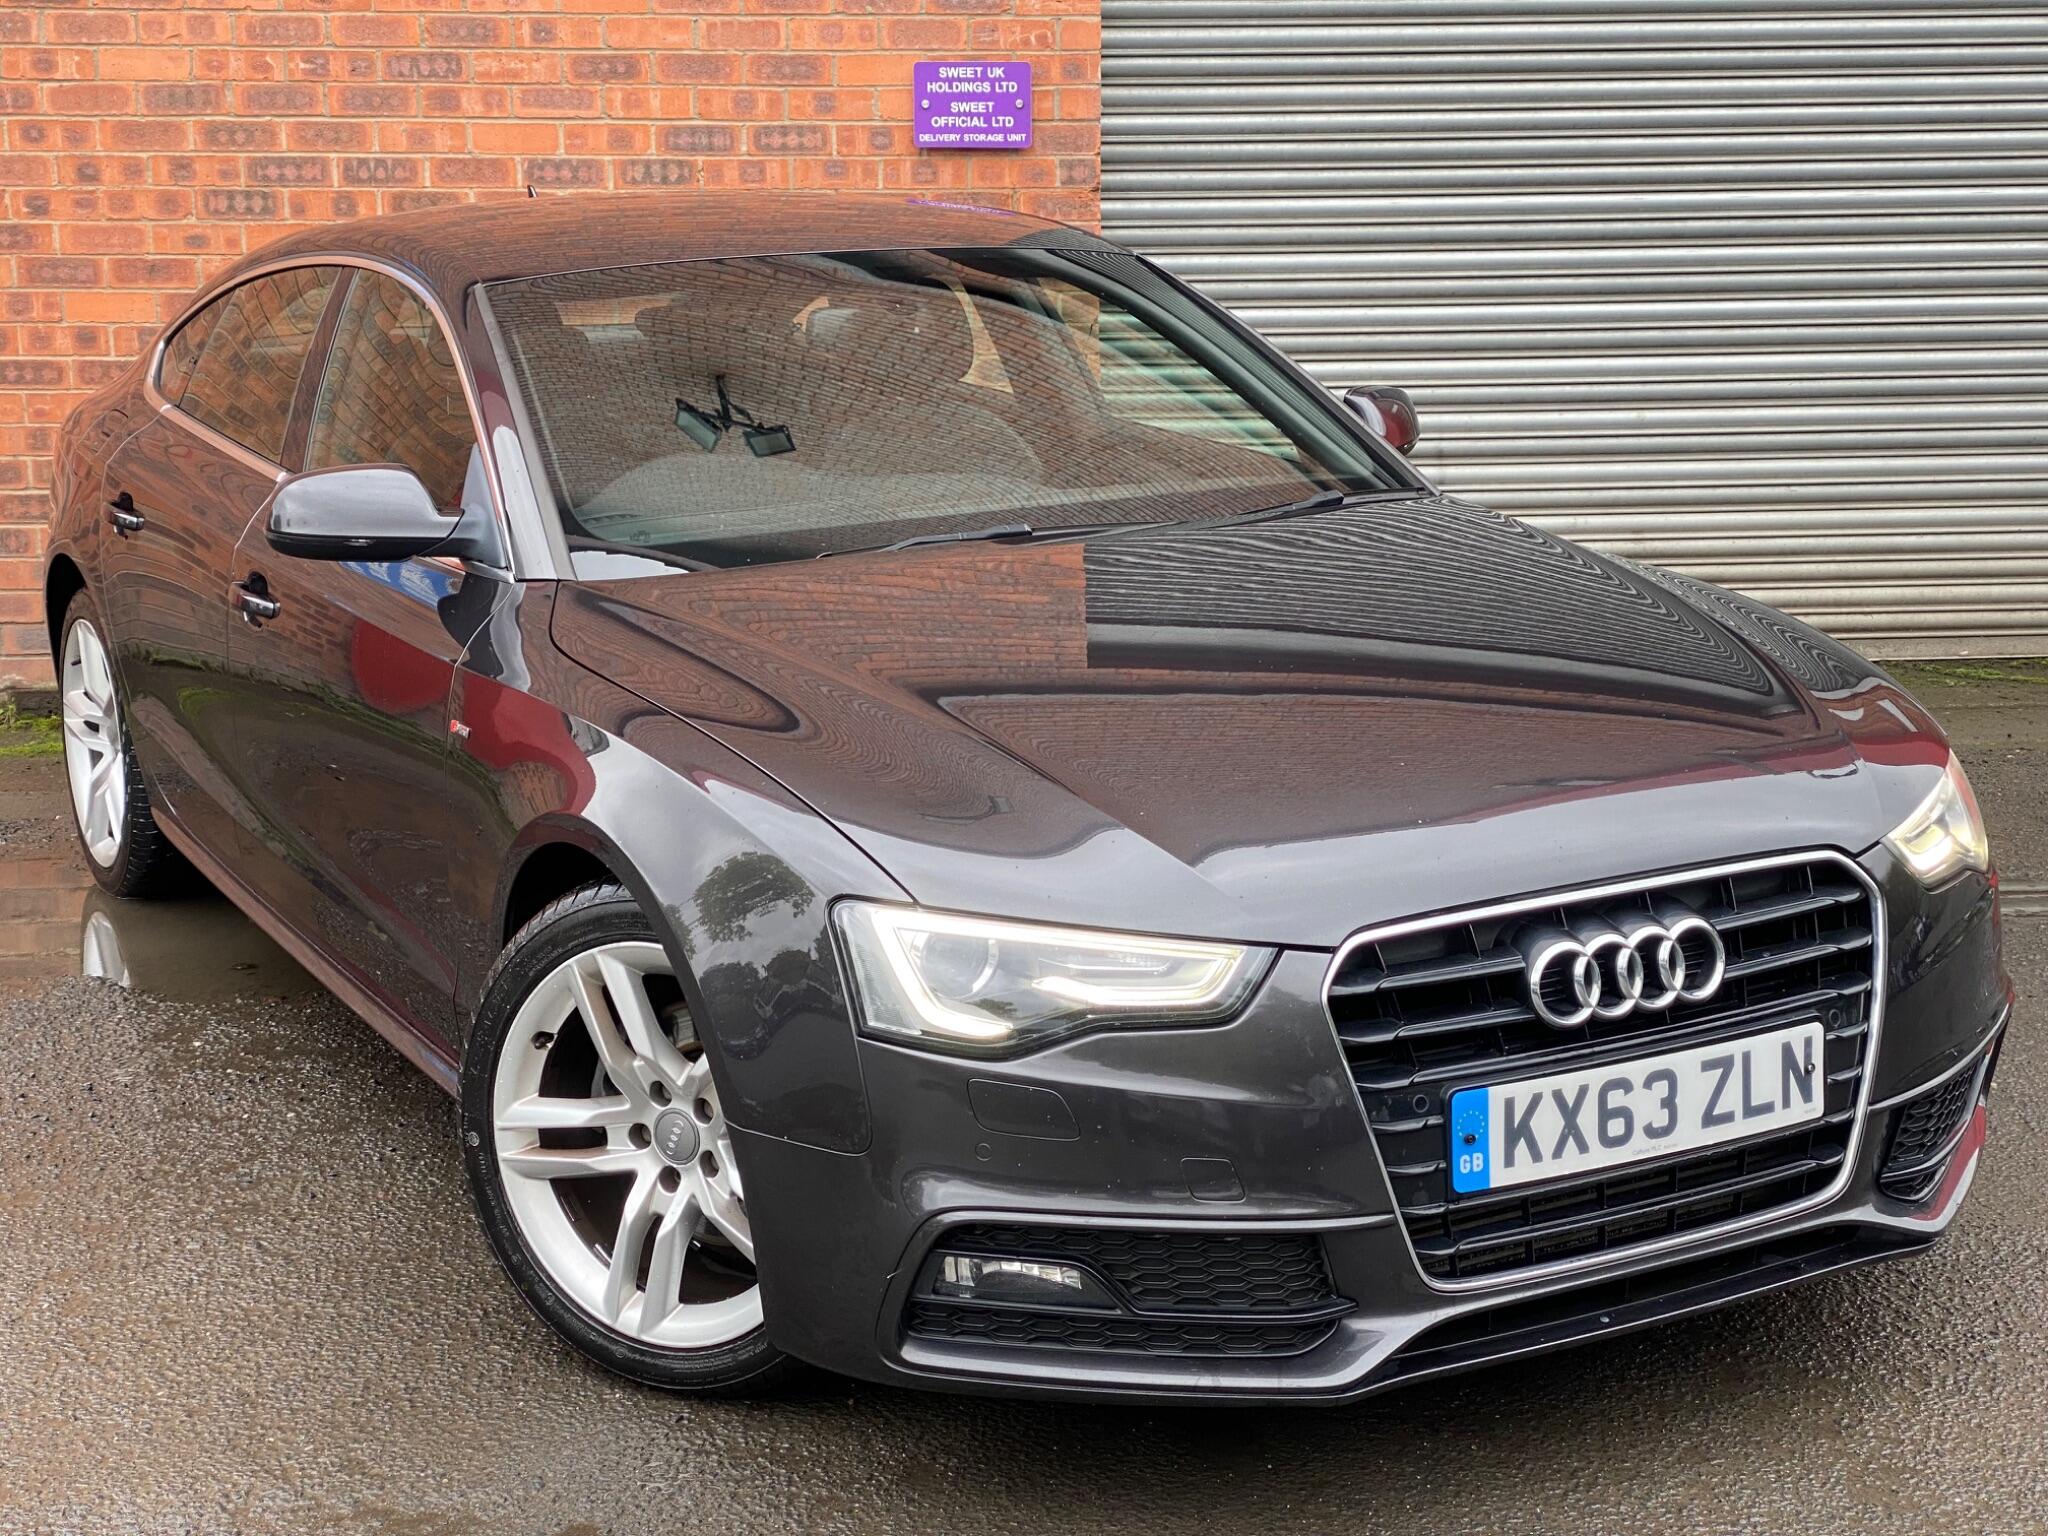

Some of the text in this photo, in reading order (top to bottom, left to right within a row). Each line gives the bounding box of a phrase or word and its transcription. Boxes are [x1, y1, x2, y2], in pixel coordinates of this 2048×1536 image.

[938, 66, 1005, 78] SWEET UK
[926, 81, 1018, 93] HOLDINGS LTD
[950, 101, 995, 113] SWEET
[931, 116, 1014, 127] OFFICIAL LTD
[919, 133, 1027, 142] DELIVERY STORAGE UNIT
[1503, 1035, 1814, 1169] KX63 ZLN
[1459, 1152, 1484, 1174] GB
